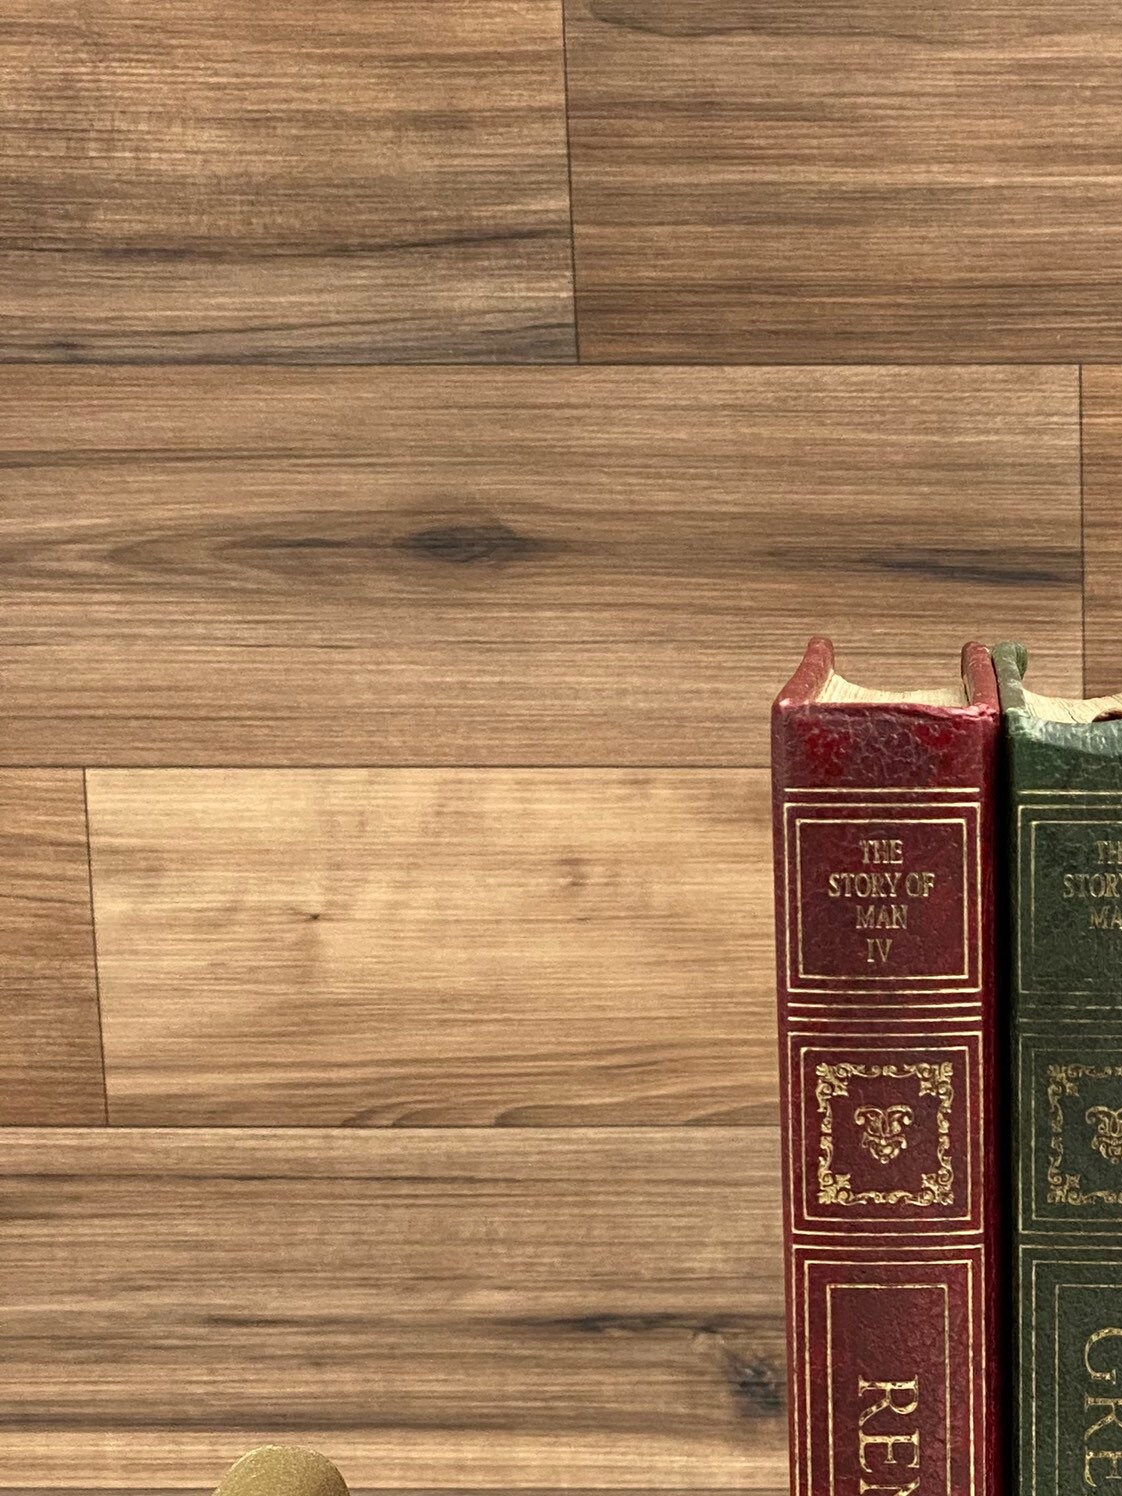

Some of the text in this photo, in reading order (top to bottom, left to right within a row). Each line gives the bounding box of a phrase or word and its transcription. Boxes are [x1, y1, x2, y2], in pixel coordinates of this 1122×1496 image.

[860, 840, 904, 863] THE
[828, 873, 935, 899] STORY OF
[856, 905, 908, 930] MAN
[866, 939, 892, 963] IV
